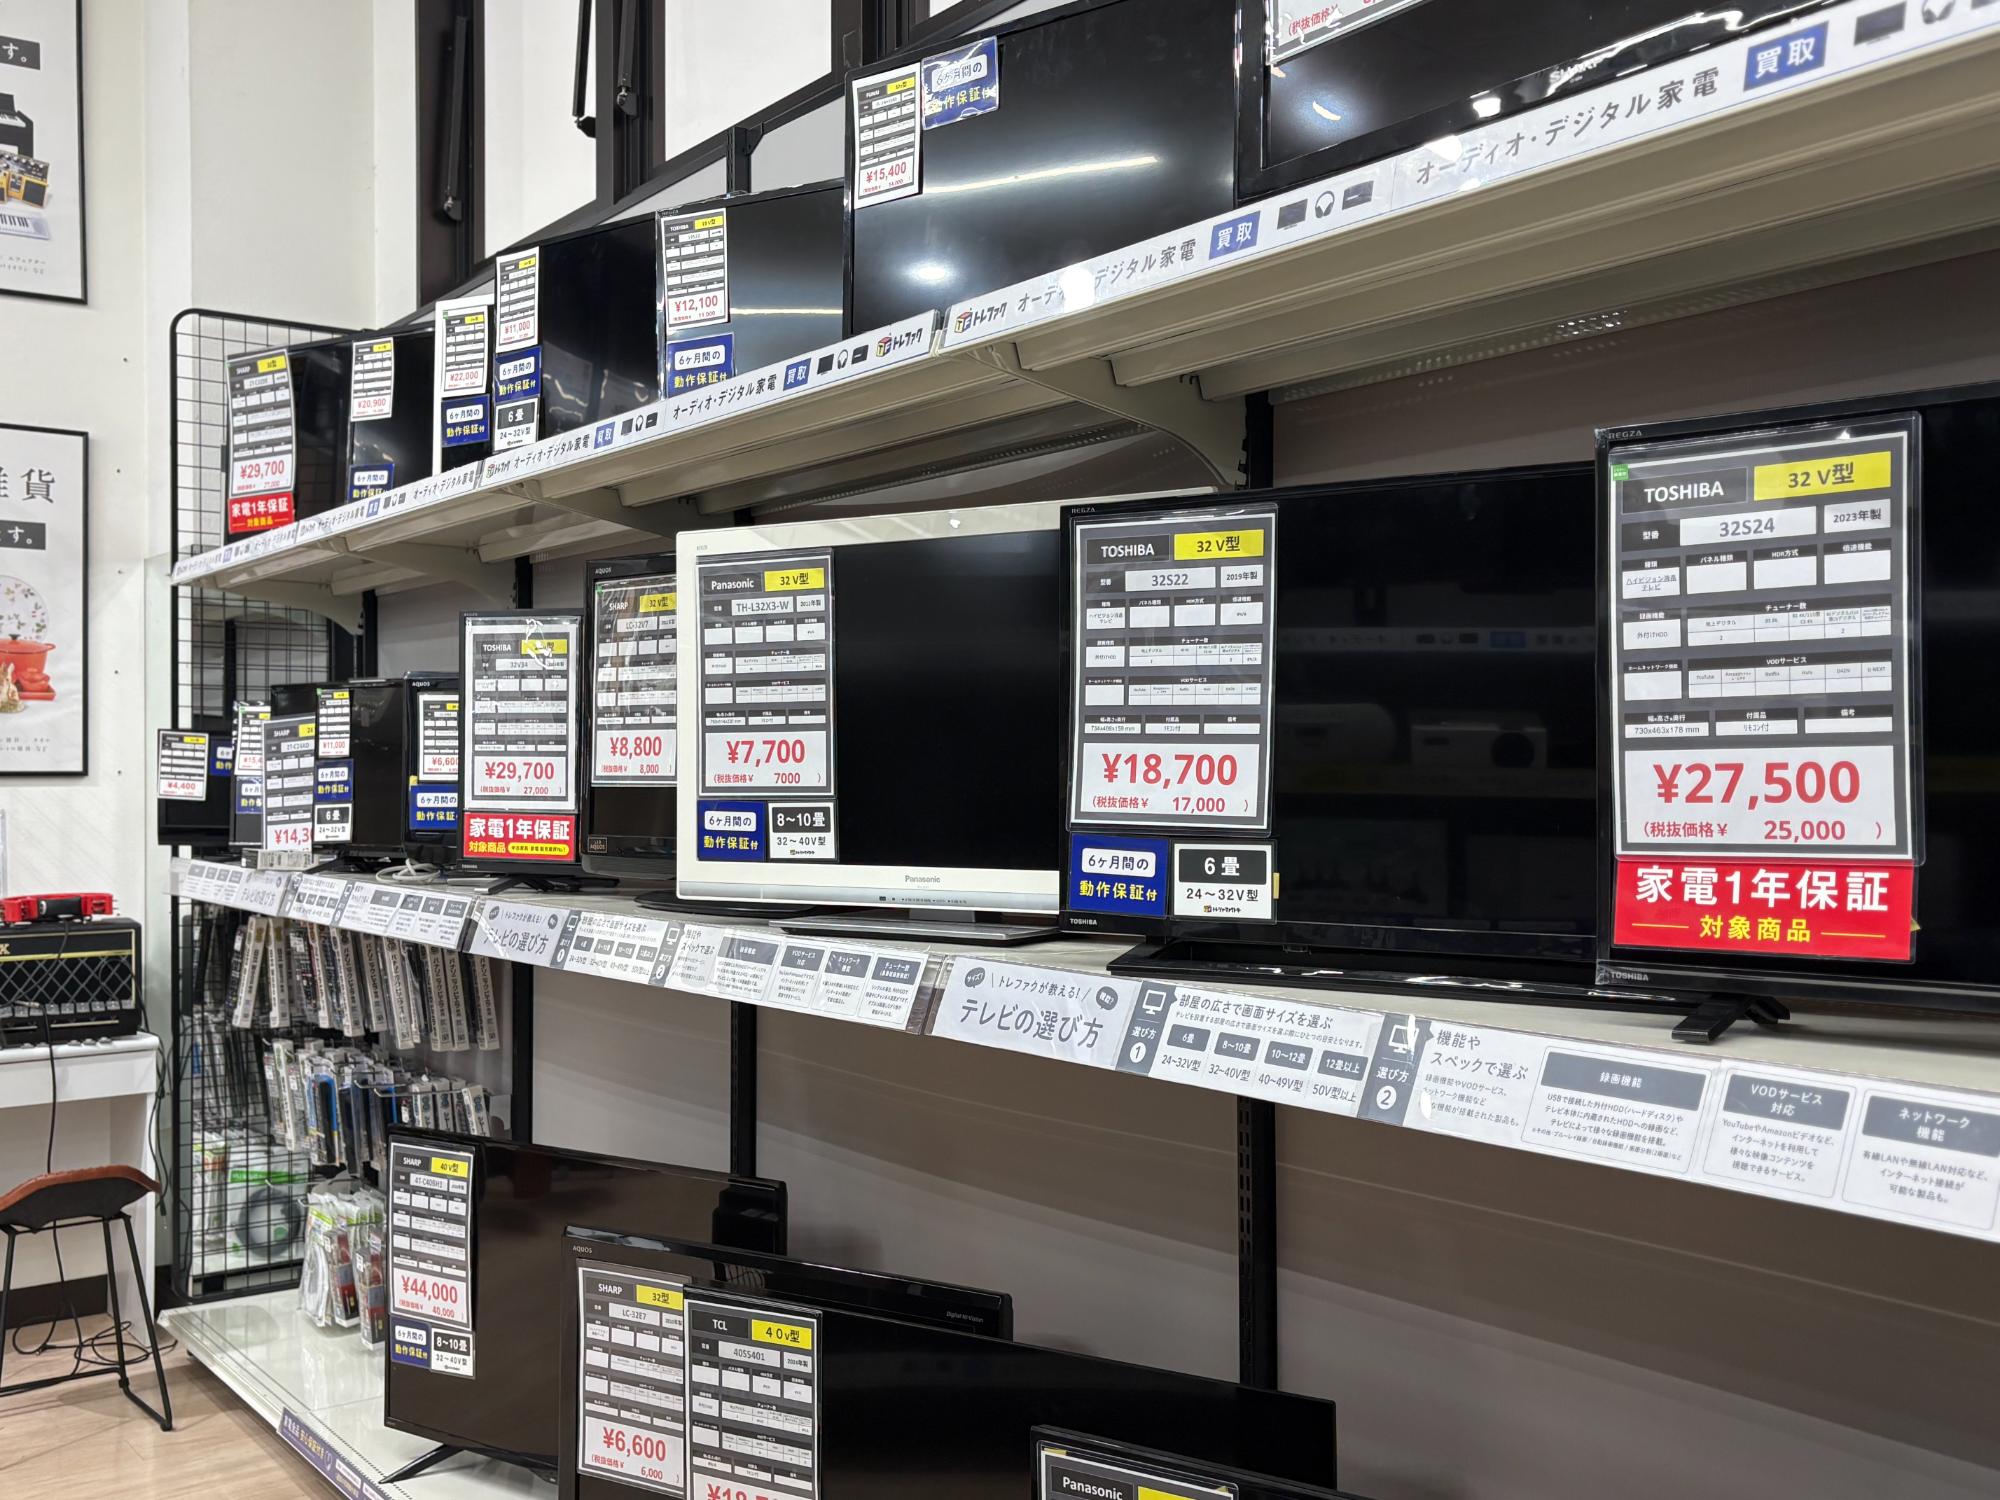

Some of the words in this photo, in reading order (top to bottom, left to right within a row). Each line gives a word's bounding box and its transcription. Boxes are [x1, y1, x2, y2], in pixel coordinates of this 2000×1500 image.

[1417, 67, 1719, 185] オーディオ・デジタル家電
[1754, 36, 1815, 79] 買取
[866, 161, 906, 183] ¥15,400
[973, 303, 1007, 327] トレファク
[1018, 238, 1197, 312] オーデデジタル家電
[1217, 221, 1253, 249] 買取
[675, 295, 718, 313] ¥12,100
[679, 350, 720, 366] 6ヶ月間の
[450, 370, 479, 382] ¥22,000
[502, 361, 532, 376] 6ヶ月間の
[673, 373, 777, 421] オーディオ・デジタル家電
[786, 364, 807, 385] 買取
[892, 328, 922, 351] トレファク
[358, 398, 386, 409] ¥20,900
[449, 408, 480, 420] 6ヶ月間の
[508, 408, 524, 423] 6畳
[1608, 430, 1643, 439] REGZA
[240, 460, 285, 479] ¥29,700
[1788, 471, 1811, 488] 32
[1816, 462, 1854, 485] V型
[1643, 480, 1724, 503] TOSHIBA
[231, 497, 289, 519] 家電1年保証
[1643, 530, 1659, 540] 型番
[1719, 517, 1775, 538] 32S24
[1833, 508, 1882, 523] 2023年製
[1101, 543, 1155, 558] TOSHIBA
[1197, 541, 1212, 553] 32
[1216, 536, 1240, 552] V型
[711, 578, 754, 590] Panasonic
[780, 576, 791, 586] 32
[792, 572, 809, 585] V型
[1151, 574, 1189, 587] 32S22
[1226, 571, 1257, 581] 2019年製
[609, 602, 629, 611] SHARP
[649, 599, 656, 608] 32
[736, 601, 789, 612] TH-L32X3-W
[1765, 602, 1807, 612] チューナー数
[483, 644, 511, 652] TOSHIBA
[1766, 656, 1807, 665] VODサービス
[323, 741, 345, 749] ¥11,000
[610, 736, 662, 760] ¥8,800
[726, 739, 805, 767] ¥7,700
[485, 762, 554, 782] ¥29,700
[640, 764, 659, 775] 8,000
[774, 772, 801, 784] 7000
[1101, 753, 1238, 789] ¥18,700
[168, 782, 196, 790] ¥4,400
[523, 787, 549, 795] 27,000
[1653, 761, 1861, 810] ¥27,500
[421, 795, 457, 804] 6ヶ月間の
[1092, 796, 1148, 809] (税抜価格¥
[1172, 797, 1225, 814] 17,000
[469, 818, 570, 840] 家電1年保証
[709, 816, 752, 827] 6ヶ月間の
[1643, 821, 1728, 838] (税抜価格¥
[1763, 820, 1846, 844] 25,000
[469, 841, 506, 853] 対象商品
[703, 836, 759, 850] 動作保証付
[1088, 854, 1149, 871] 6ヶ月間の
[1204, 856, 1240, 876] 6畳
[904, 875, 941, 883] Panasonic
[1079, 880, 1157, 902] 動作保証付
[1635, 864, 1890, 912] 家電1年保証
[1700, 915, 1811, 942] 対象商品
[1610, 970, 1649, 982] TOSHIBA
[999, 975, 1081, 999] トレファクが教える!
[1178, 994, 1333, 1030] 部屋の広さで画面サイズを選ぶ
[960, 999, 1104, 1048] テレビの選び方
[1131, 1026, 1157, 1040] 選び方
[1436, 1029, 1481, 1050] 機能や
[1182, 1033, 1195, 1044] 6畳
[1325, 1058, 1360, 1075] 12畳以上
[1376, 1066, 1410, 1083] 選び方
[1430, 1052, 1529, 1081] スペックで選ぶ
[1599, 1071, 1643, 1088] 録画機能
[1312, 1083, 1357, 1103] 50V型以上
[1751, 1085, 1823, 1105] VODサービス
[1770, 1103, 1795, 1116] 対応
[1898, 1107, 1971, 1129] ネットワーク
[1916, 1126, 1945, 1142] 機能
[1731, 1134, 1819, 1157] インターネットを利用して
[403, 1157, 421, 1167] SHARP
[1730, 1146, 1814, 1170] 様々な映像コンテンツを
[440, 1163, 448, 1171] 40
[1731, 1160, 1806, 1182] 視聴できるサービス。
[1880, 1169, 1965, 1191] インターネット接続が
[1889, 1184, 1949, 1204] 可能な製品も。
[572, 1245, 593, 1254] AQUOS
[401, 1275, 458, 1304] ¥44,000
[598, 1283, 623, 1295] SHARP
[652, 1292, 670, 1305] 32型
[432, 1306, 455, 1318] 40,000
[622, 1309, 647, 1321] LC-32E7
[712, 1319, 728, 1331] TCL
[603, 1426, 666, 1461] ¥6,600
[641, 1466, 663, 1480] 6,000
[1062, 1476, 1123, 1500] Panasonic
